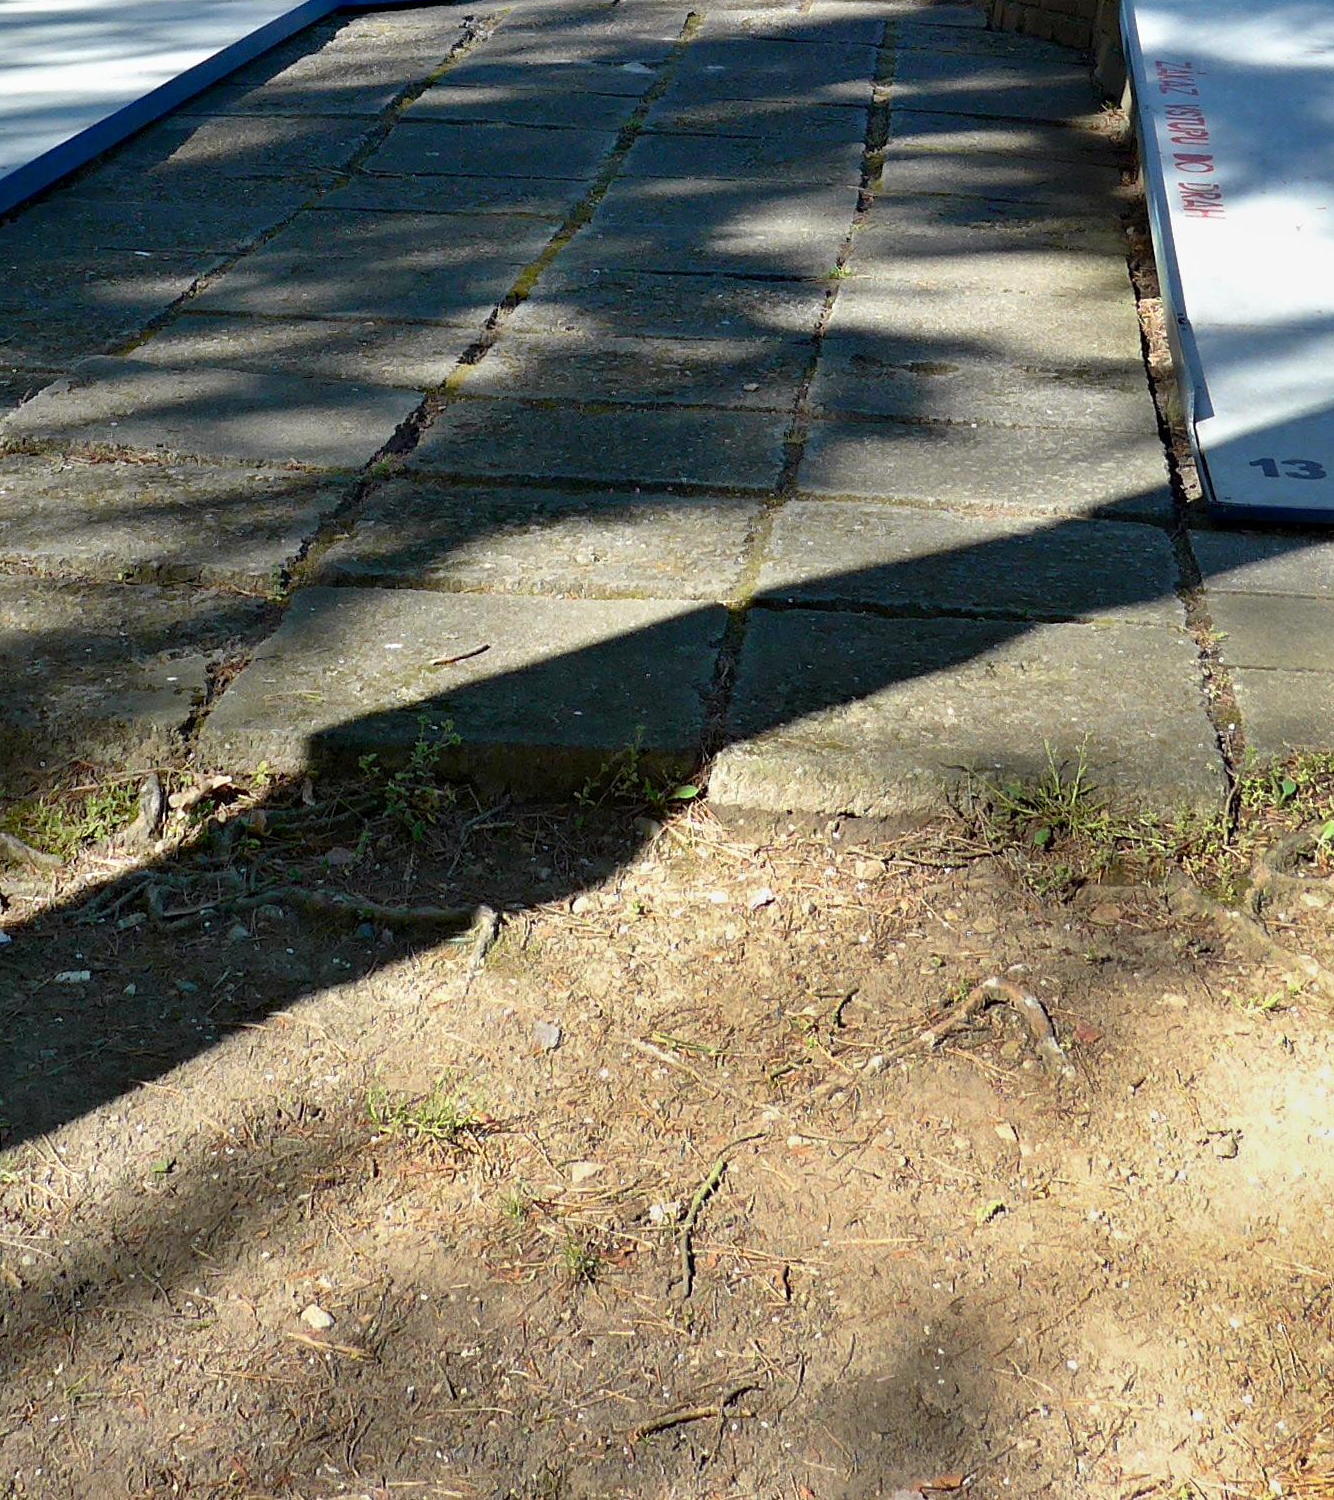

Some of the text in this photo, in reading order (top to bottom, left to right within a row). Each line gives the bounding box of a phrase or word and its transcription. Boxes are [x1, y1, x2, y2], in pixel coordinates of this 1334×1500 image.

[1155, 60, 1226, 219] ZÁKAZ VSTUPU DO DRAH
[1249, 458, 1327, 480] 13
